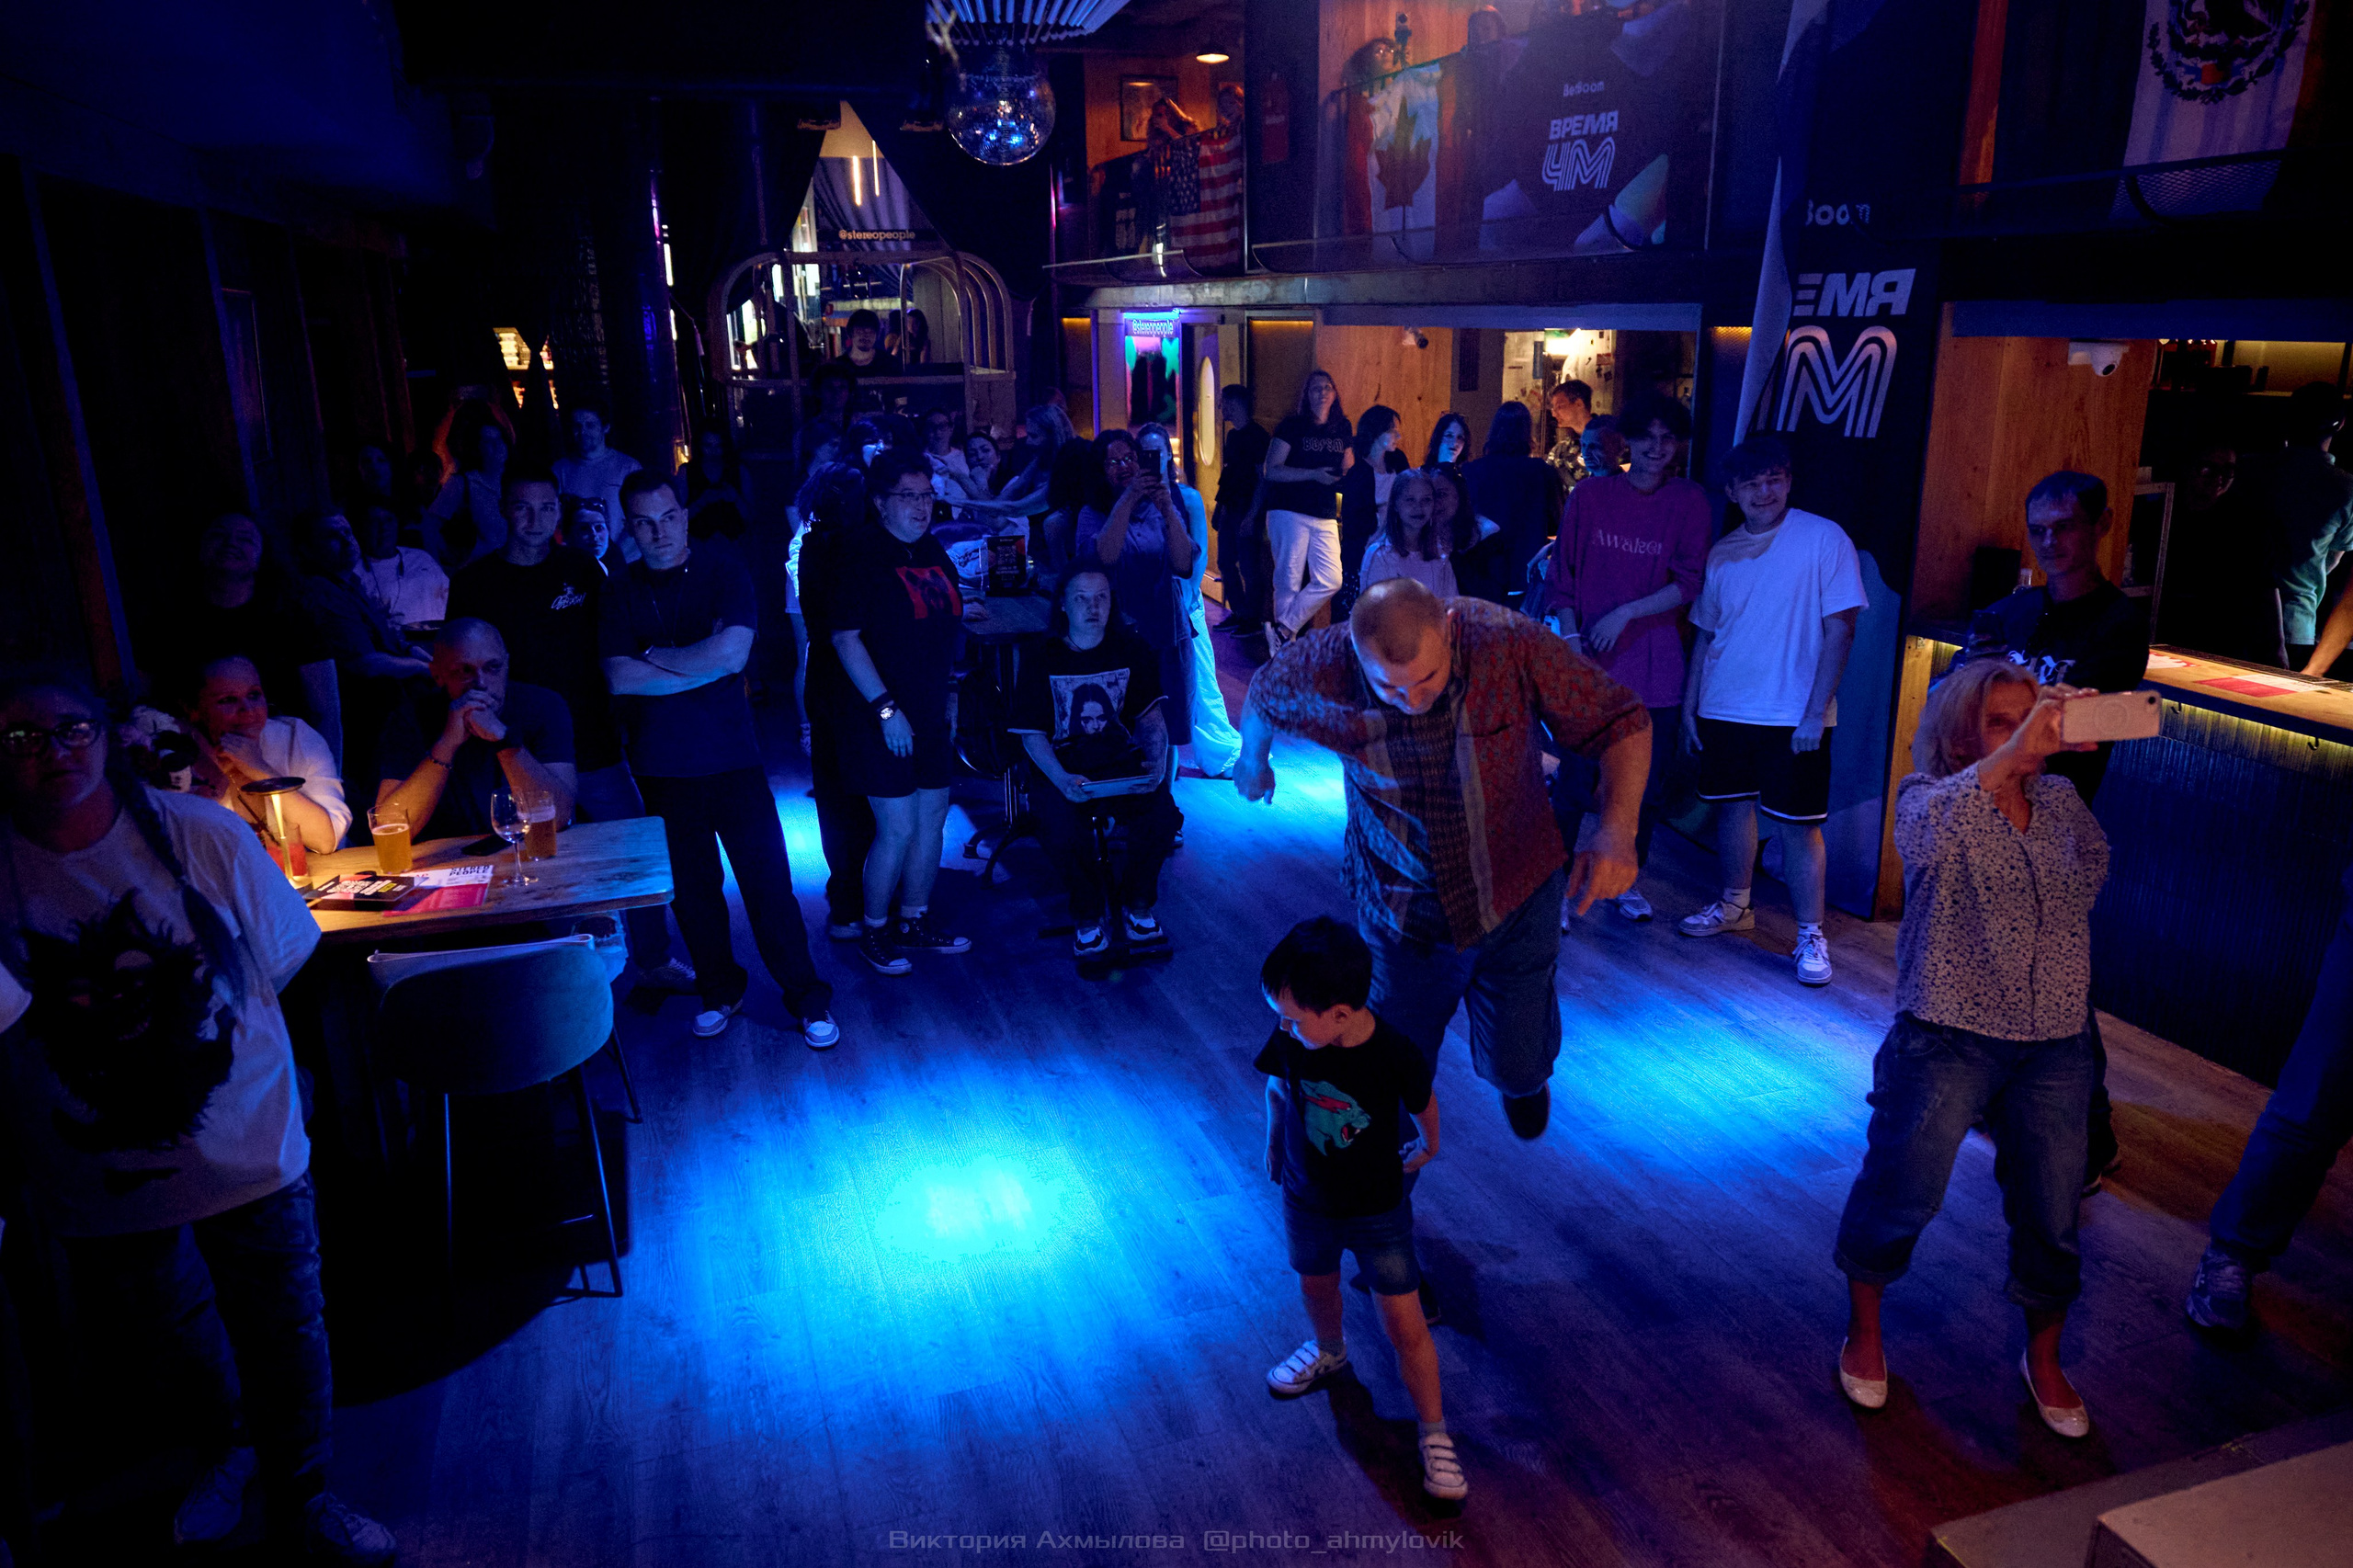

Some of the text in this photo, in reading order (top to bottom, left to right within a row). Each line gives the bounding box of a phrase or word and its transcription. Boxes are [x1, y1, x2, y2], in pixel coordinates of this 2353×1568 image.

[1549, 110, 1619, 140] ВРЕМЯ
[1541, 136, 1616, 192] ЧМ
[837, 229, 916, 242] @stereopeople
[1792, 267, 1917, 318] ЕМЯ
[1132, 319, 1175, 338] @stereopeople
